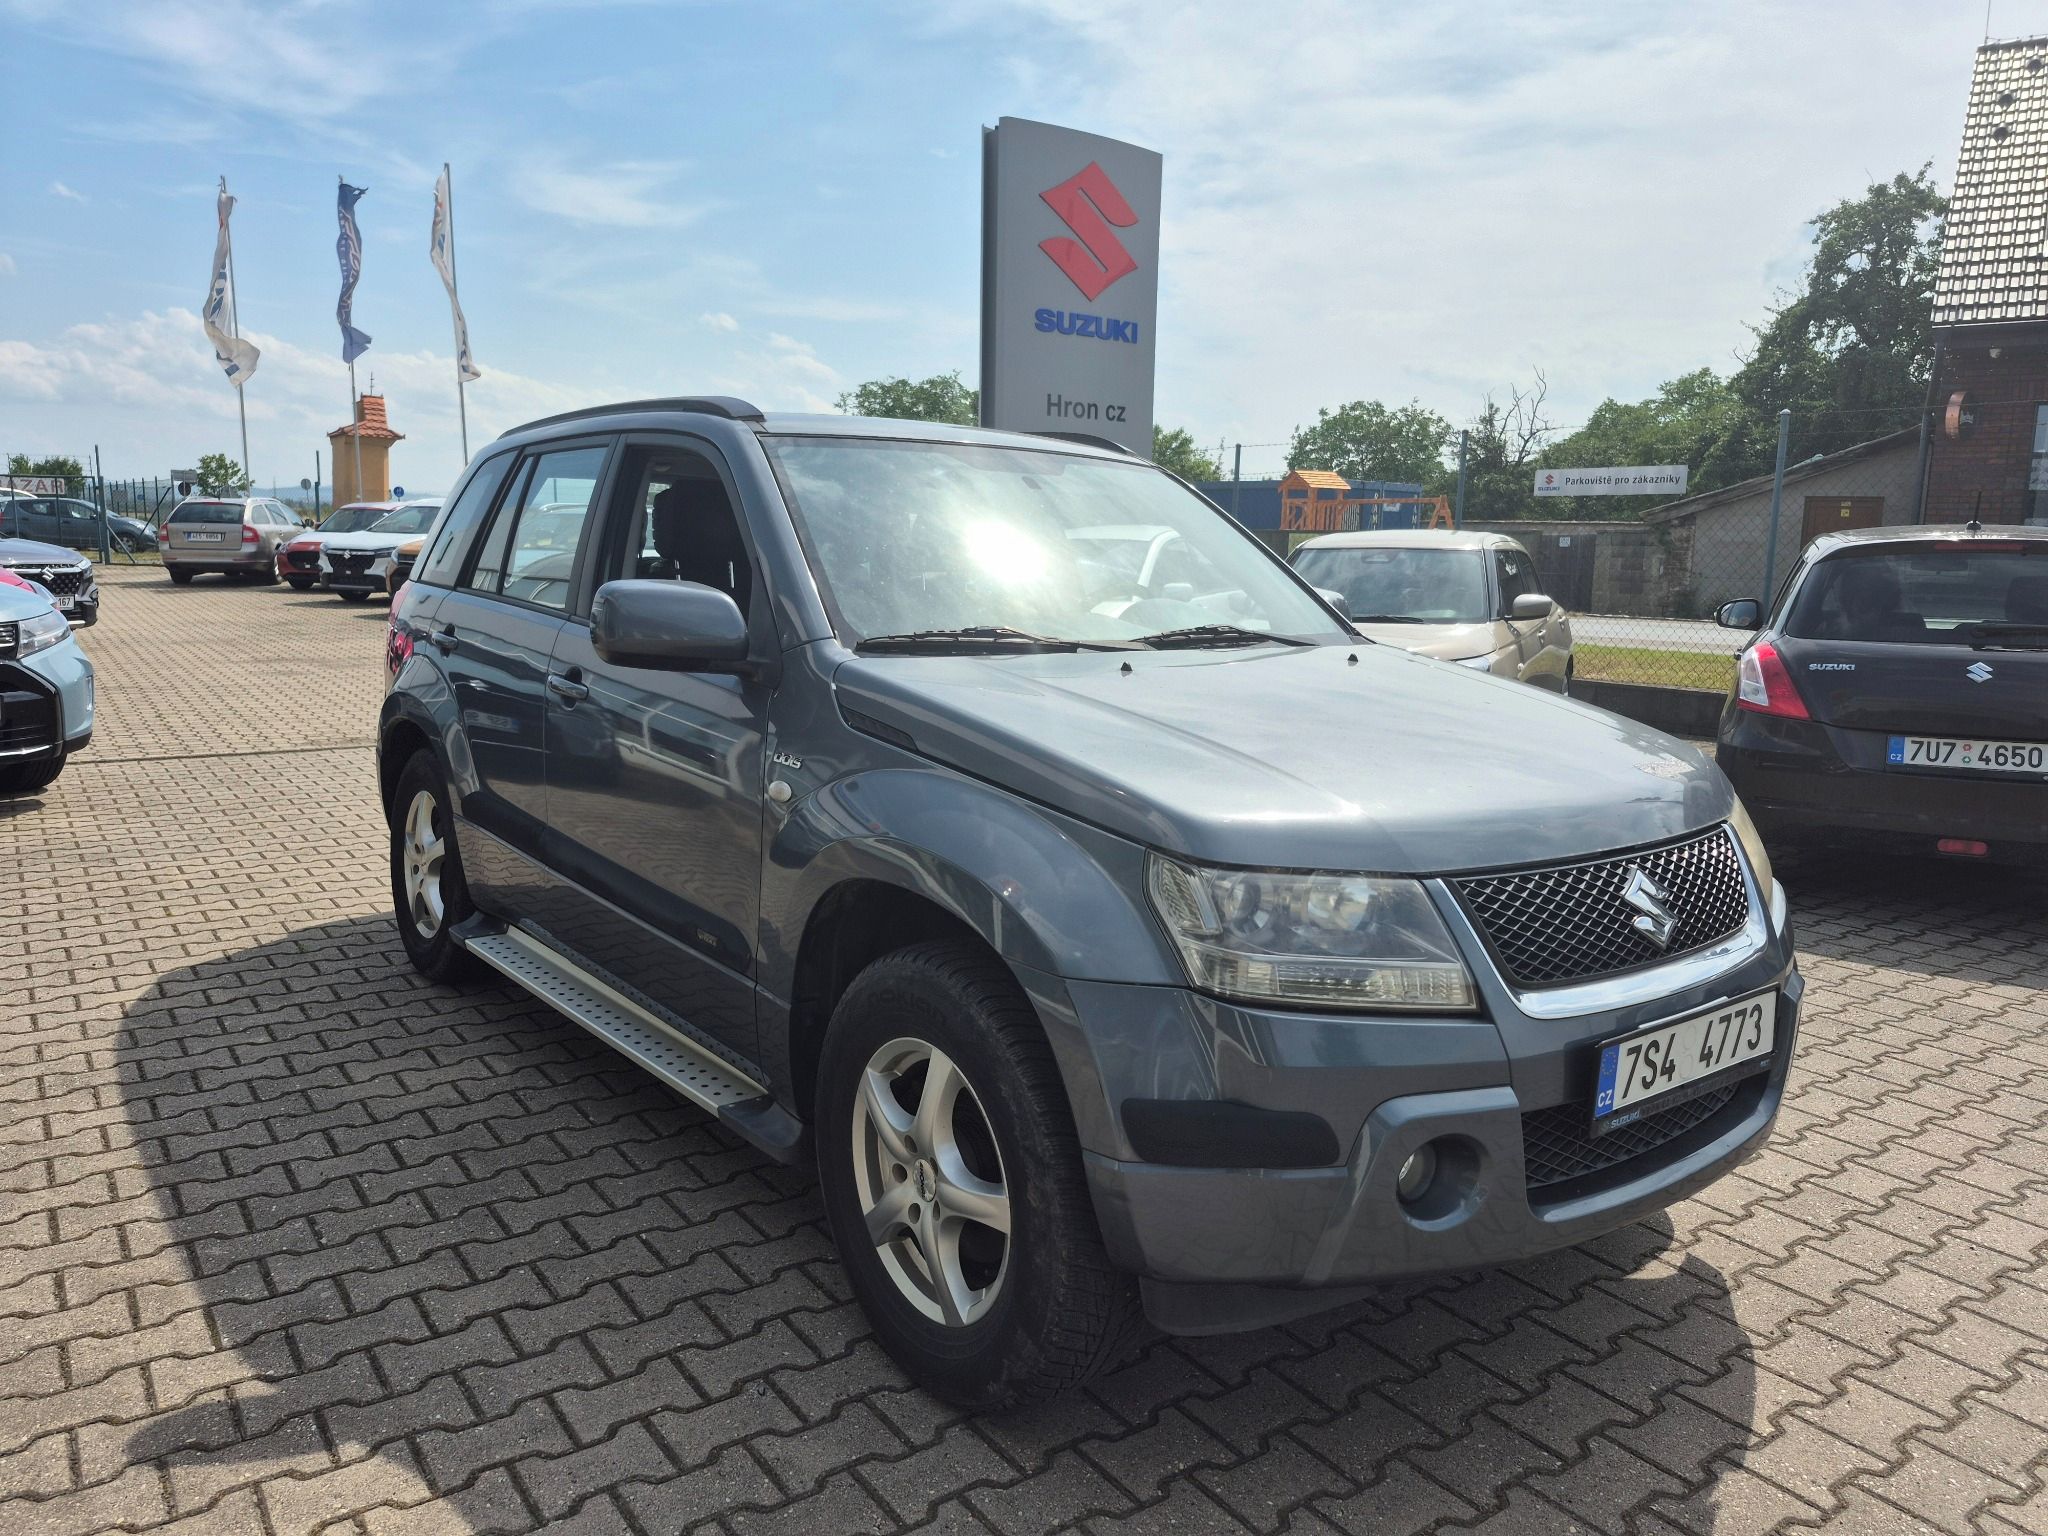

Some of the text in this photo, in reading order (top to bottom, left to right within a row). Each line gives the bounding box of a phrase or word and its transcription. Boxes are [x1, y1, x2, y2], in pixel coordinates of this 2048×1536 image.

[1034, 308, 1138, 344] SUZUKI
[1047, 393, 1126, 422] Hron cz
[0, 479, 64, 493] AZAR
[1565, 474, 1680, 486] Parkoviště pro zákazníky
[1808, 663, 1856, 671] SUZUKI
[1890, 753, 1902, 761] CZ
[1910, 740, 2043, 768] 7U7 4650
[1621, 1003, 1763, 1100] 7S4 4773
[1597, 1089, 1613, 1107] CZ
